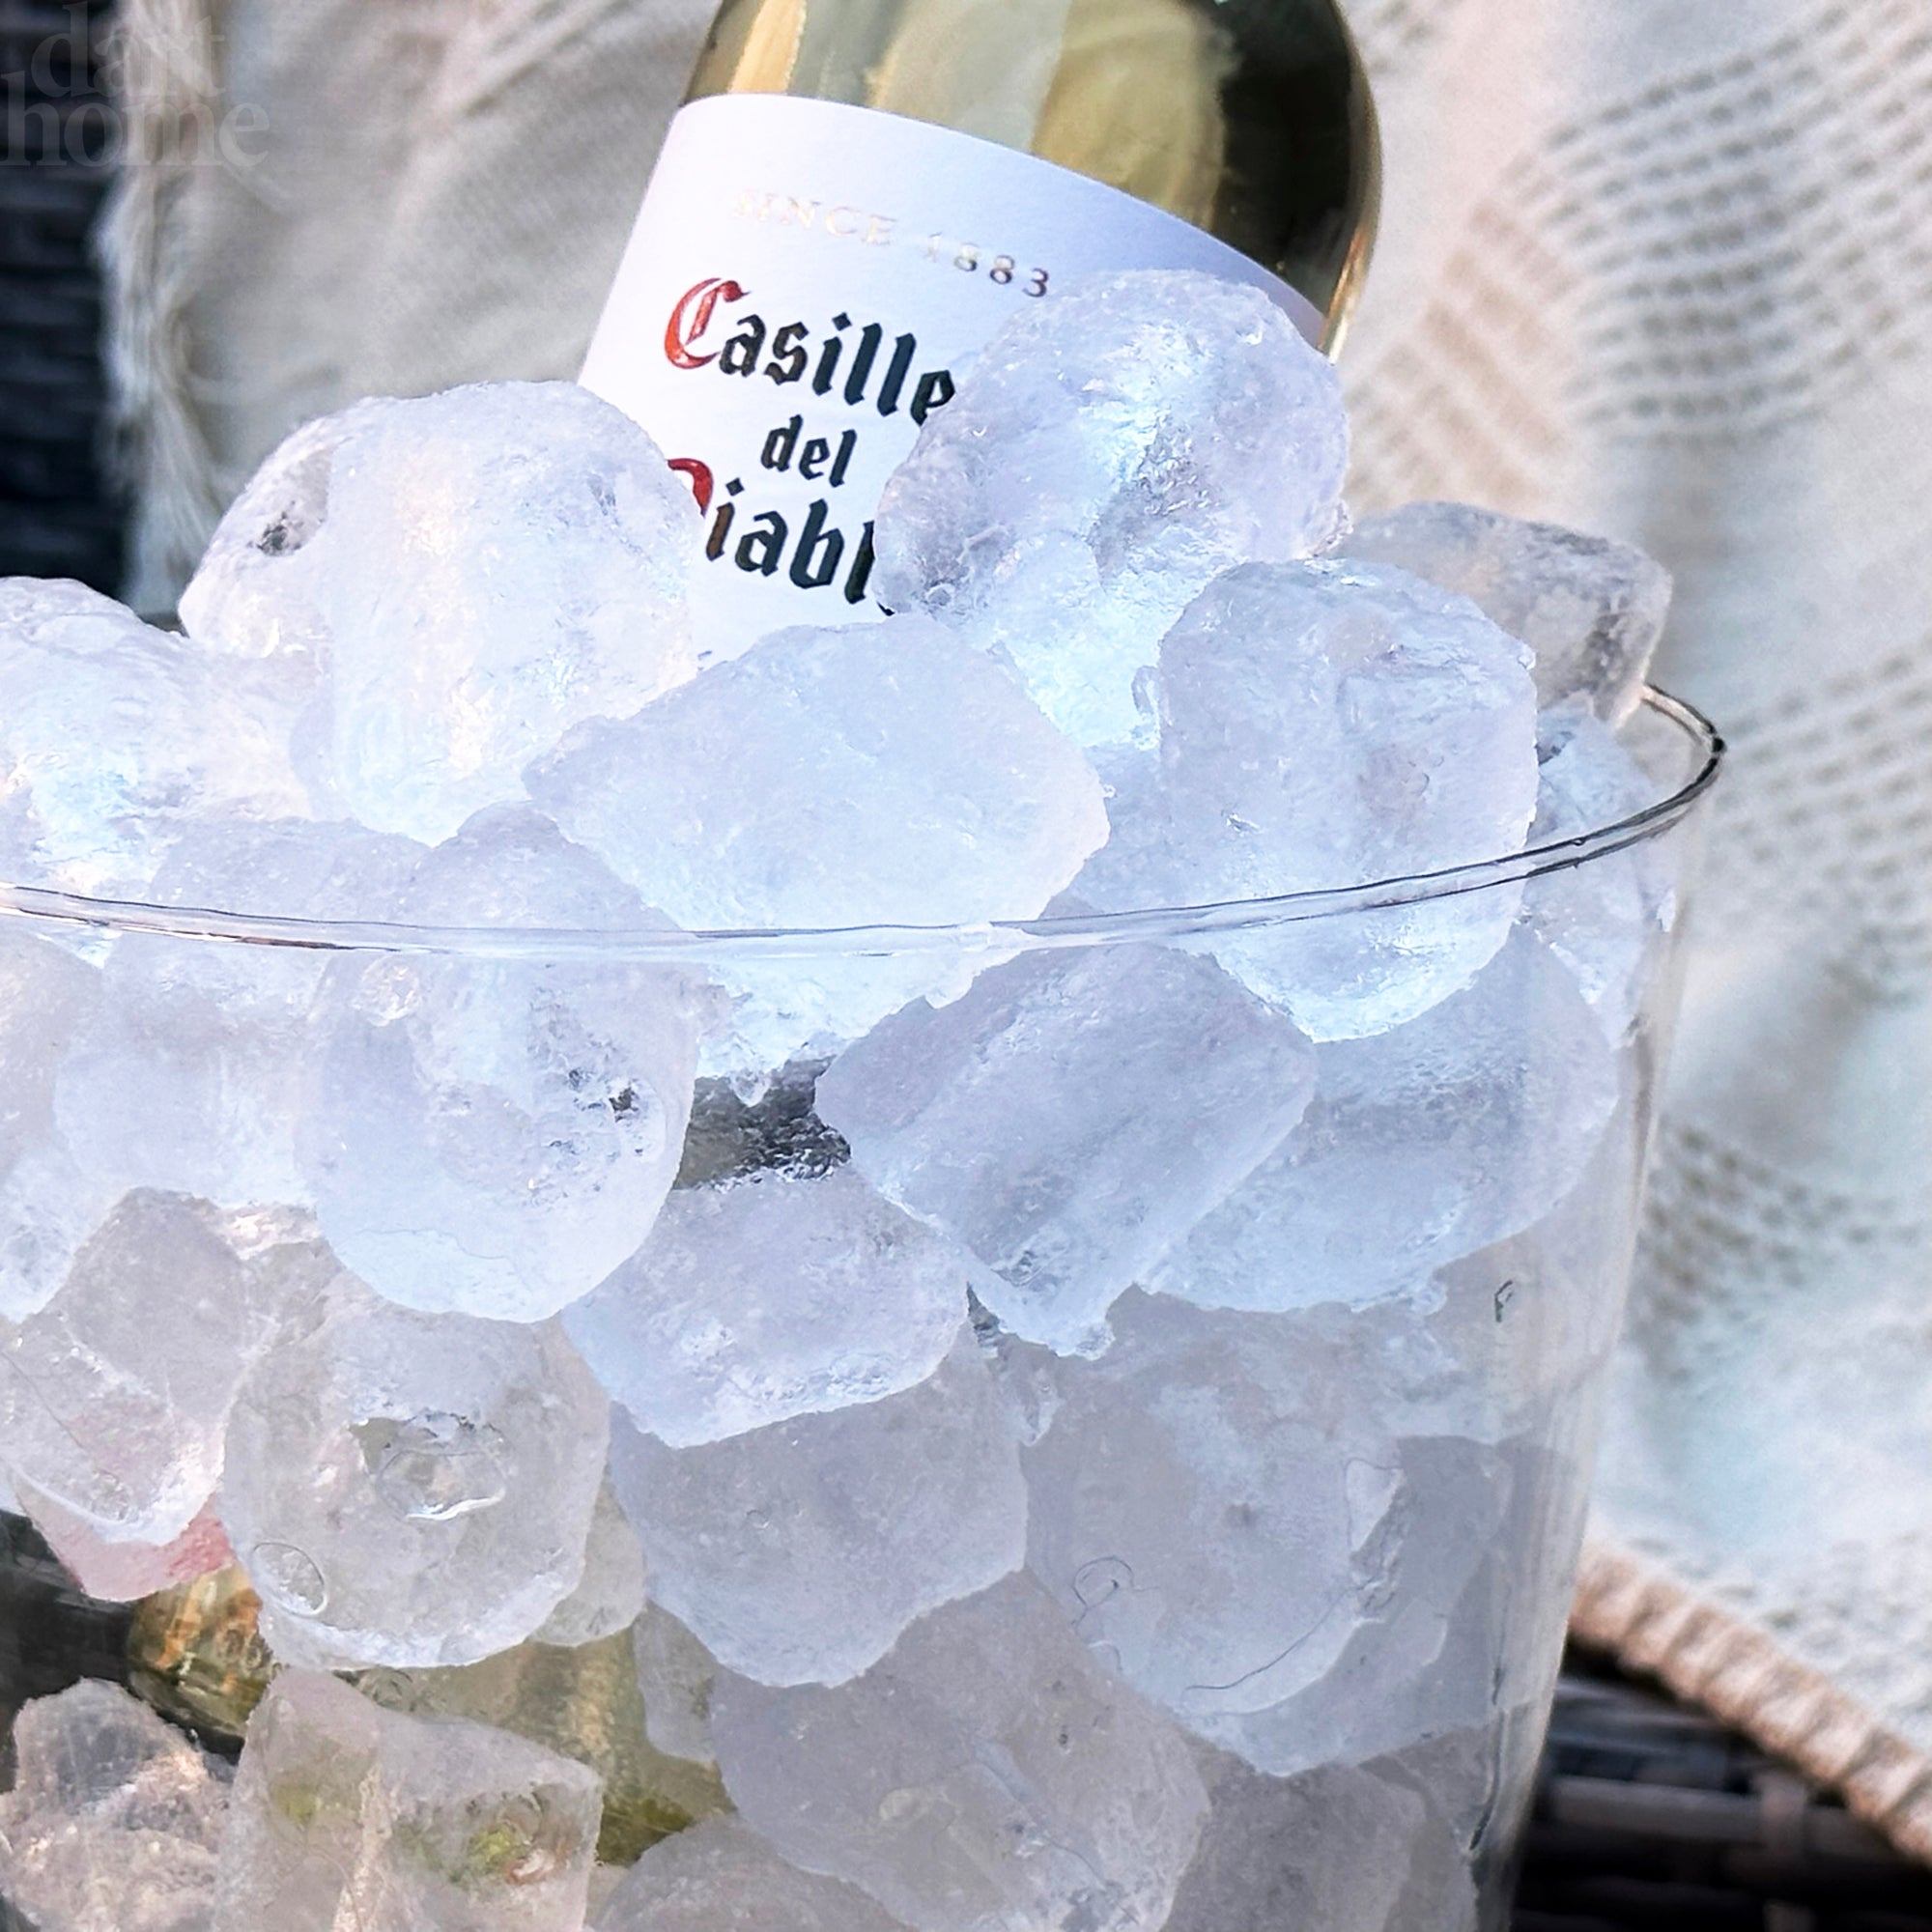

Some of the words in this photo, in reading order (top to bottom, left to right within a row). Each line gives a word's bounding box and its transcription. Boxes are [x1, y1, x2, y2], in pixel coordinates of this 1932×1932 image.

[733, 188, 897, 246] SINCE
[923, 232, 1050, 298] 1883
[760, 413, 858, 489] del
[668, 458, 895, 617] iabl
